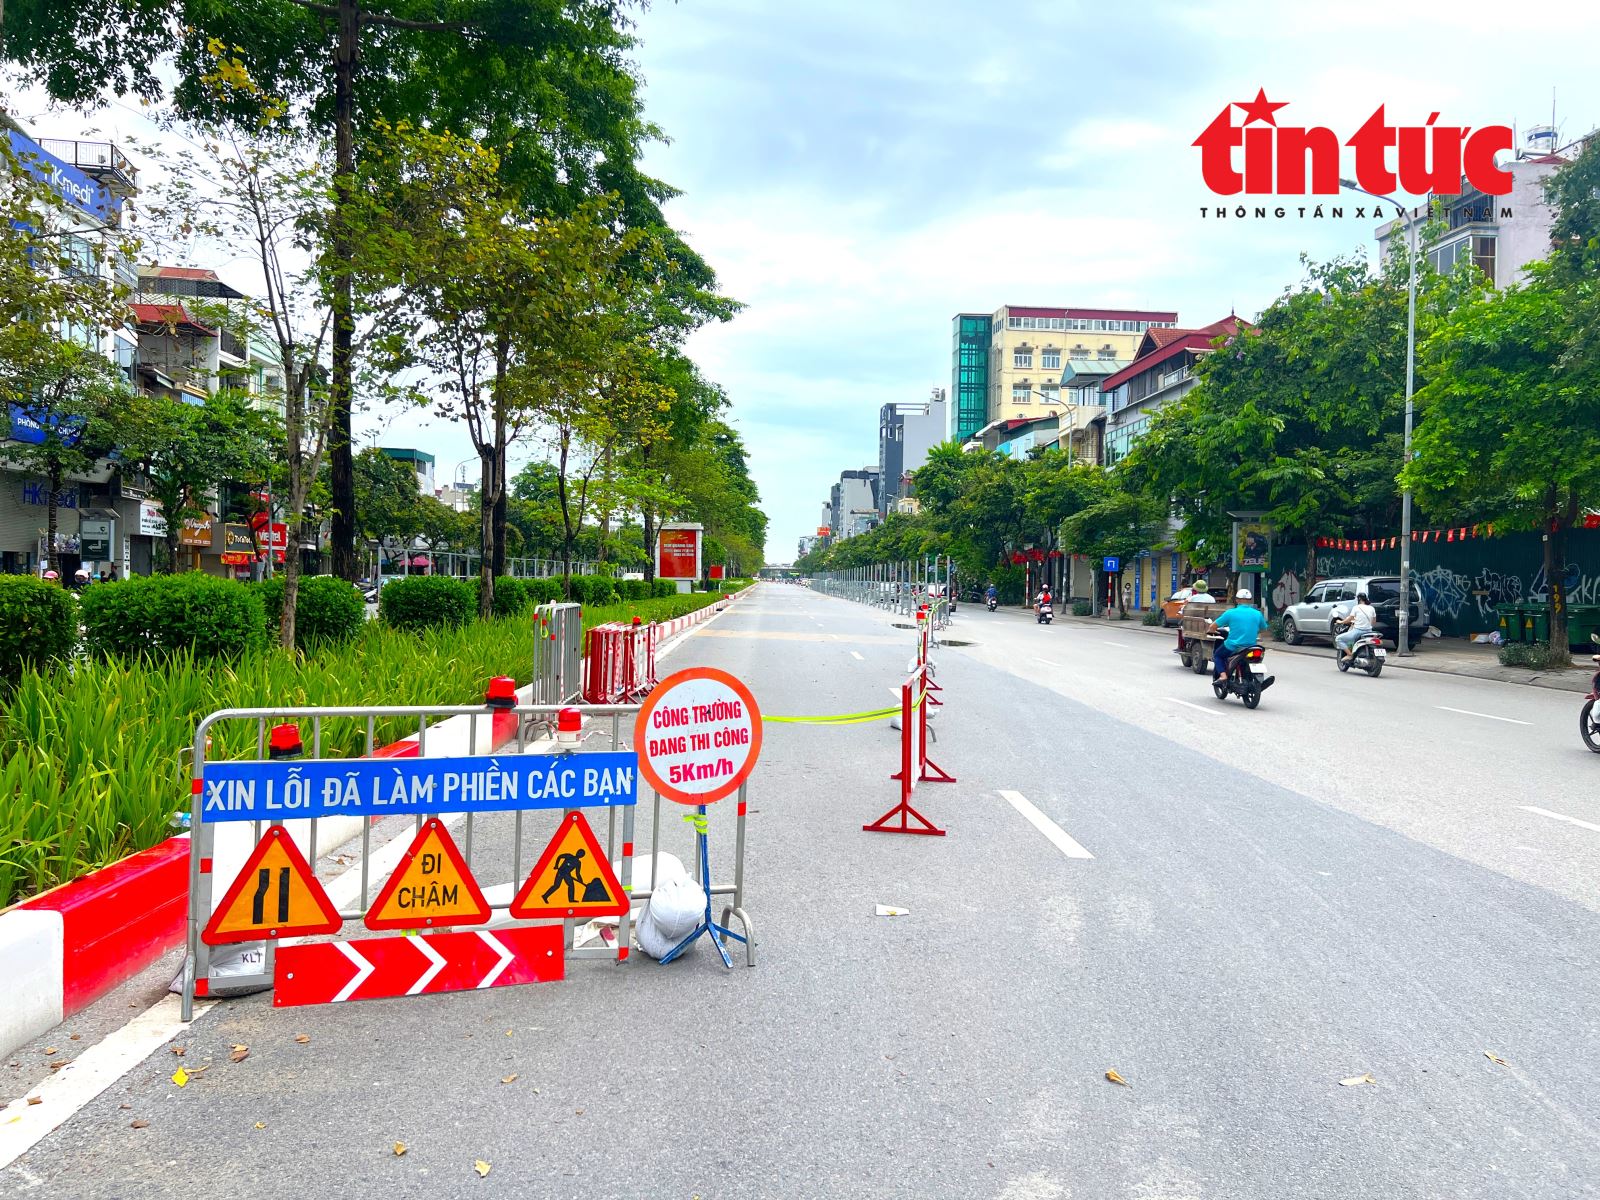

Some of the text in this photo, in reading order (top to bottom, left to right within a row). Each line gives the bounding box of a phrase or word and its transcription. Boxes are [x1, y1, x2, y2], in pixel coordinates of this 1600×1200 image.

[258, 529, 282, 543] vietel
[653, 698, 742, 729] CÔNG TRƯỜNG
[649, 727, 749, 757] ĐANG THI CÔNG
[669, 758, 734, 784] 5Km/h
[205, 759, 632, 812] XIN LỖI ĐÃ LÀM PHIỀN CÁC BẠN
[421, 853, 442, 875] ĐI
[241, 951, 264, 964] KLT
